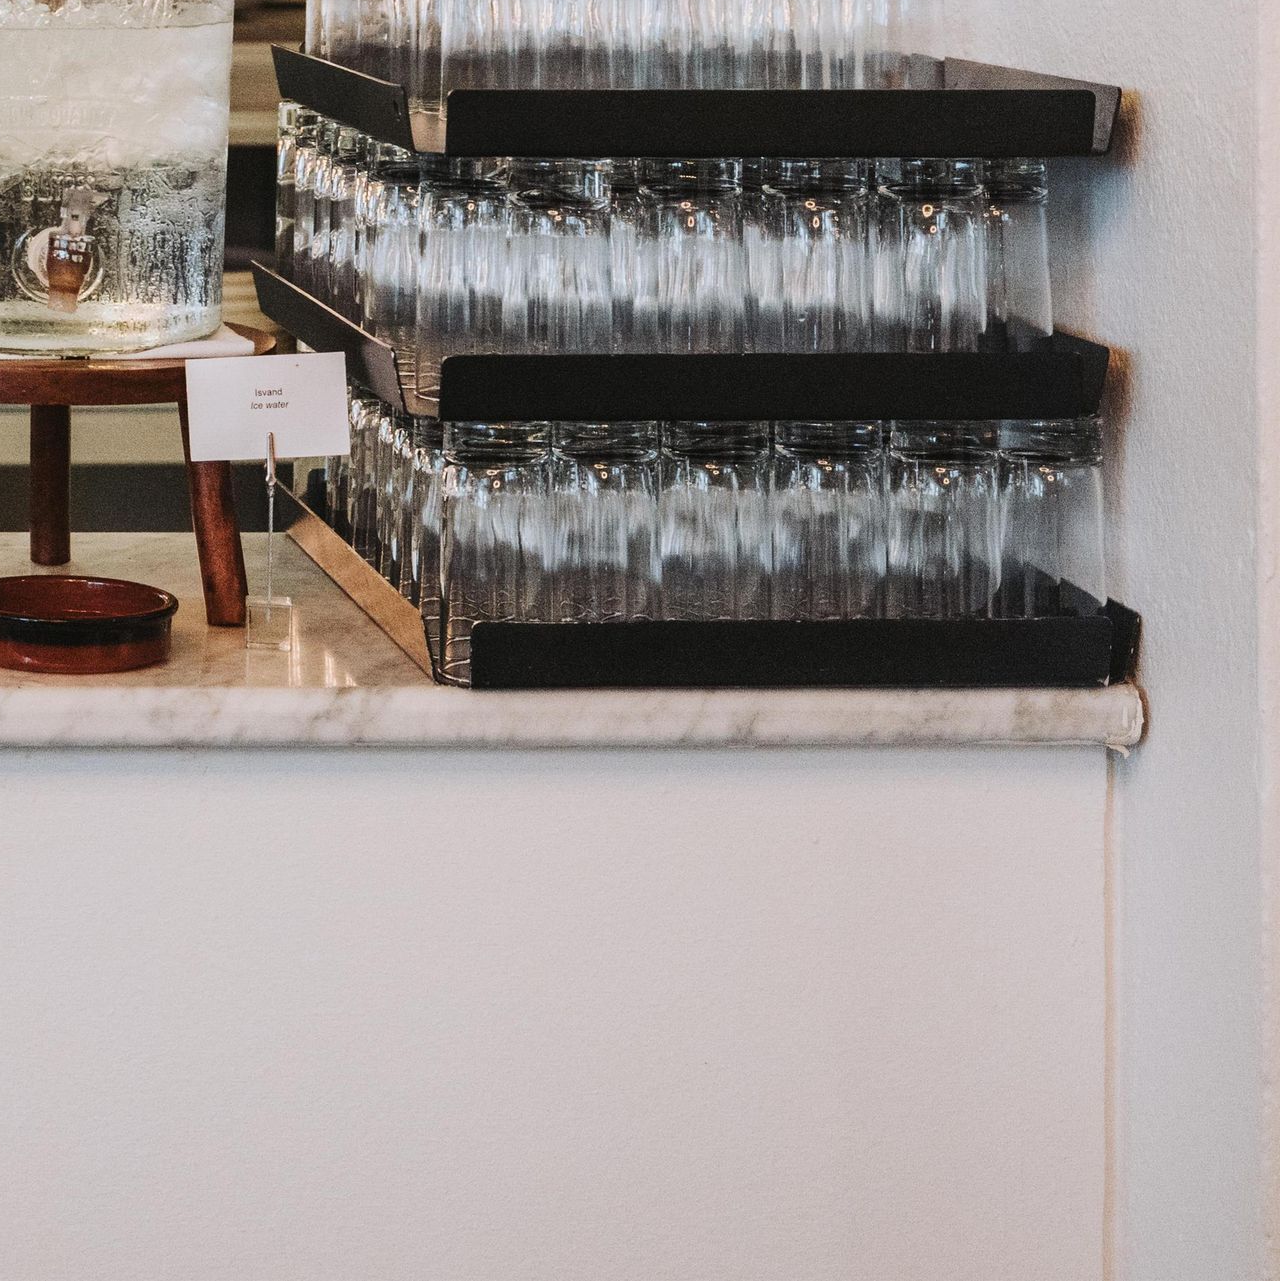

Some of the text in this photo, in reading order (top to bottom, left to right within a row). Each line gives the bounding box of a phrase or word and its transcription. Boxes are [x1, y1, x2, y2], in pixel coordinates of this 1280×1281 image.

[255, 388, 283, 397] Isvand
[250, 401, 289, 410] Ice water
